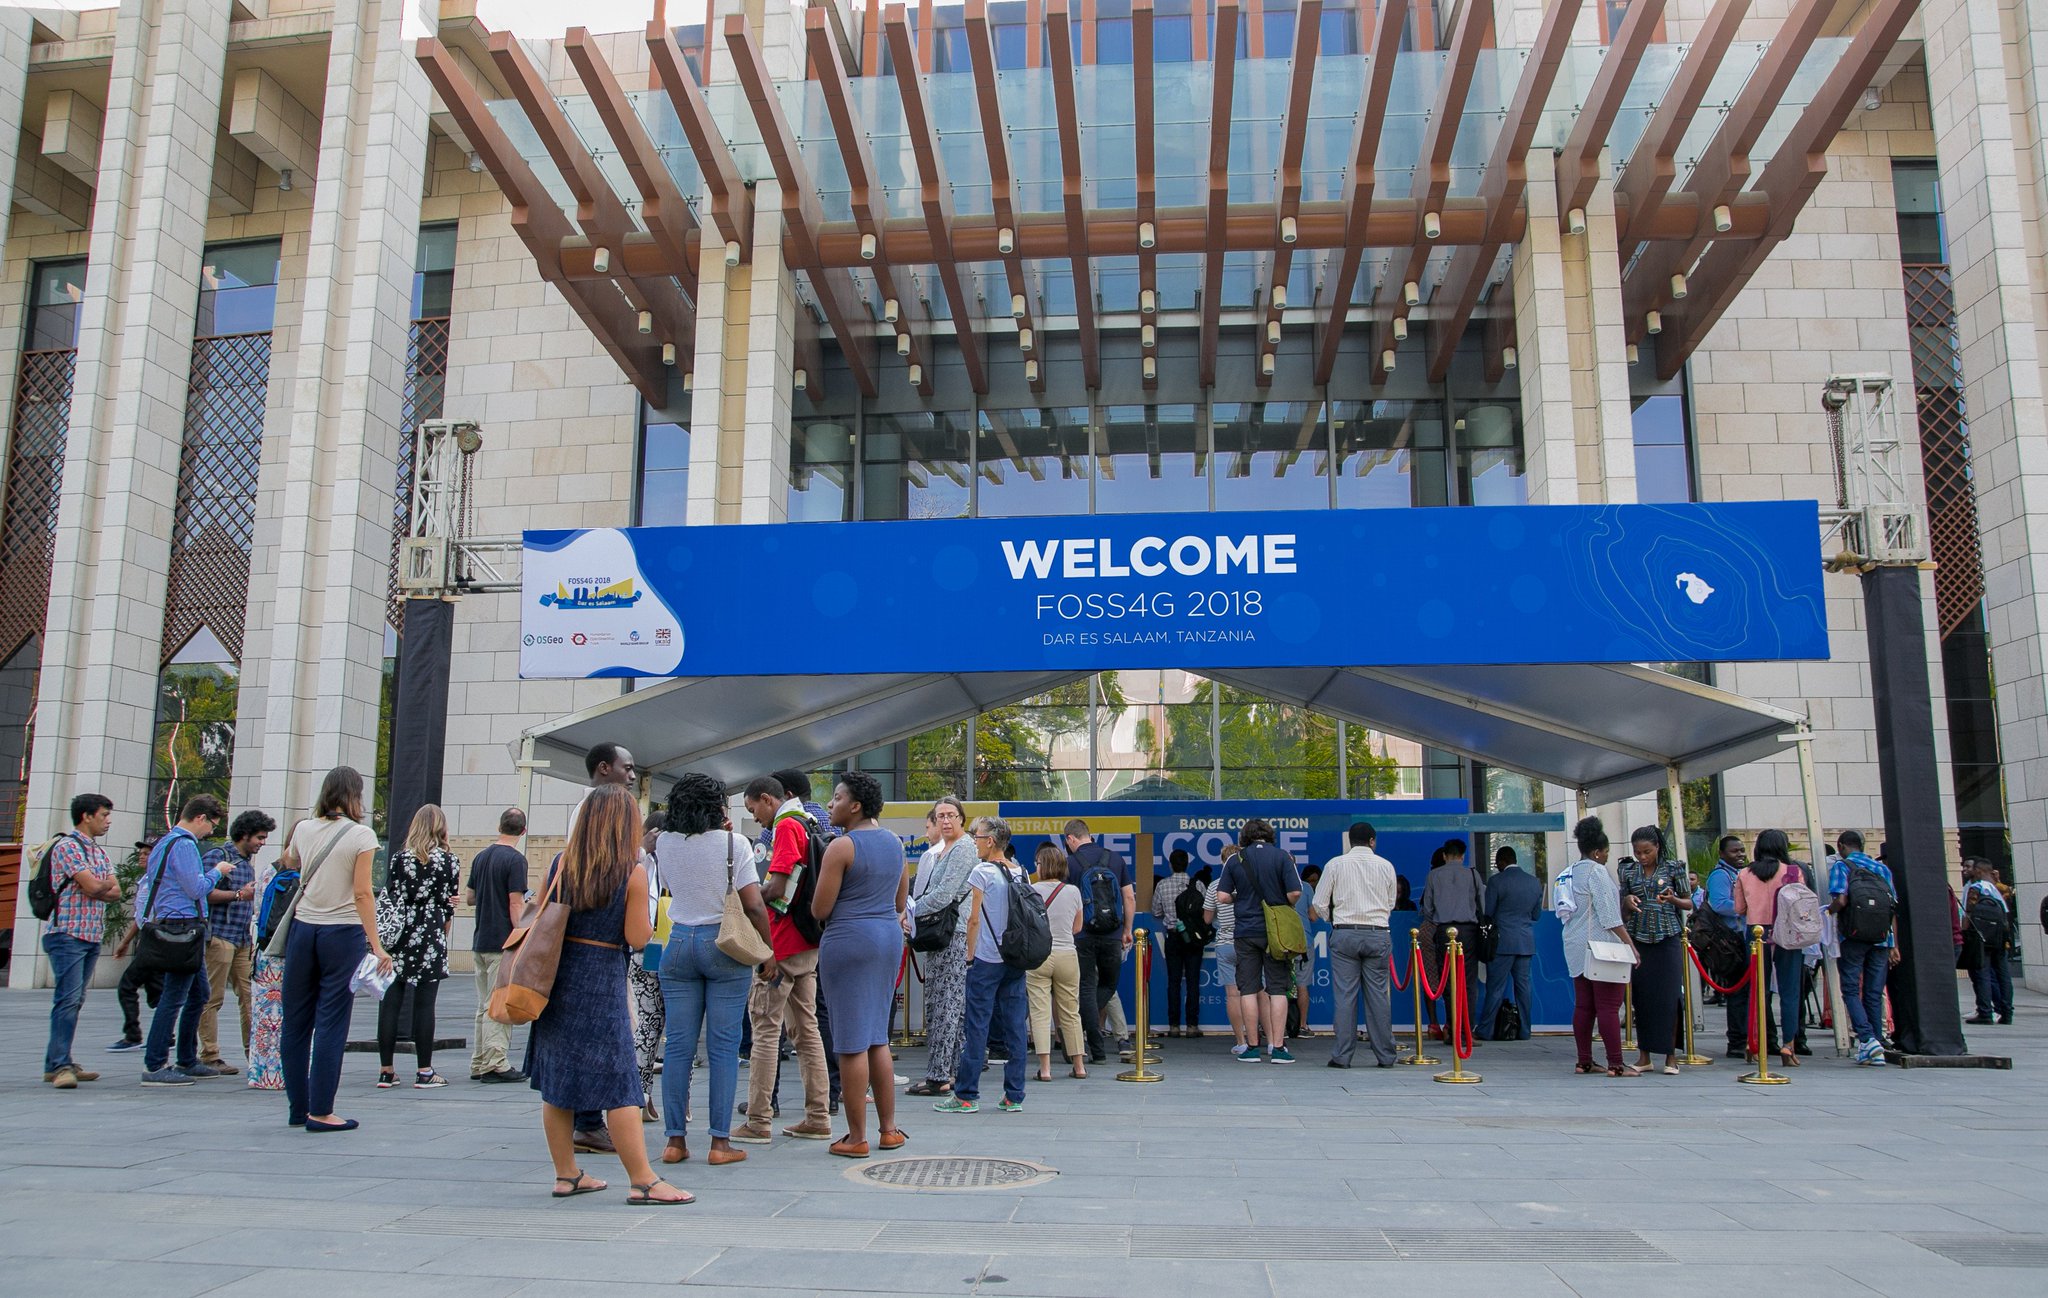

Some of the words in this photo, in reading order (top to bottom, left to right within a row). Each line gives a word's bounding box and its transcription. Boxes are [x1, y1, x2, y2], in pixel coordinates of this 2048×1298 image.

[1000, 534, 1297, 579] WELCOME
[568, 577, 593, 585] FOSS4G
[595, 576, 611, 584] 2018
[1037, 591, 1175, 620] FOSS4G
[1187, 590, 1263, 617] 2018
[536, 635, 564, 645] OSGeo
[1043, 632, 1075, 645] DAR
[1080, 632, 1099, 645] ES
[1103, 630, 1171, 645] SALAAM,
[1176, 629, 1256, 643] TANZANIA
[1179, 818, 1224, 830] BADGE
[1227, 817, 1309, 830] COCTION
